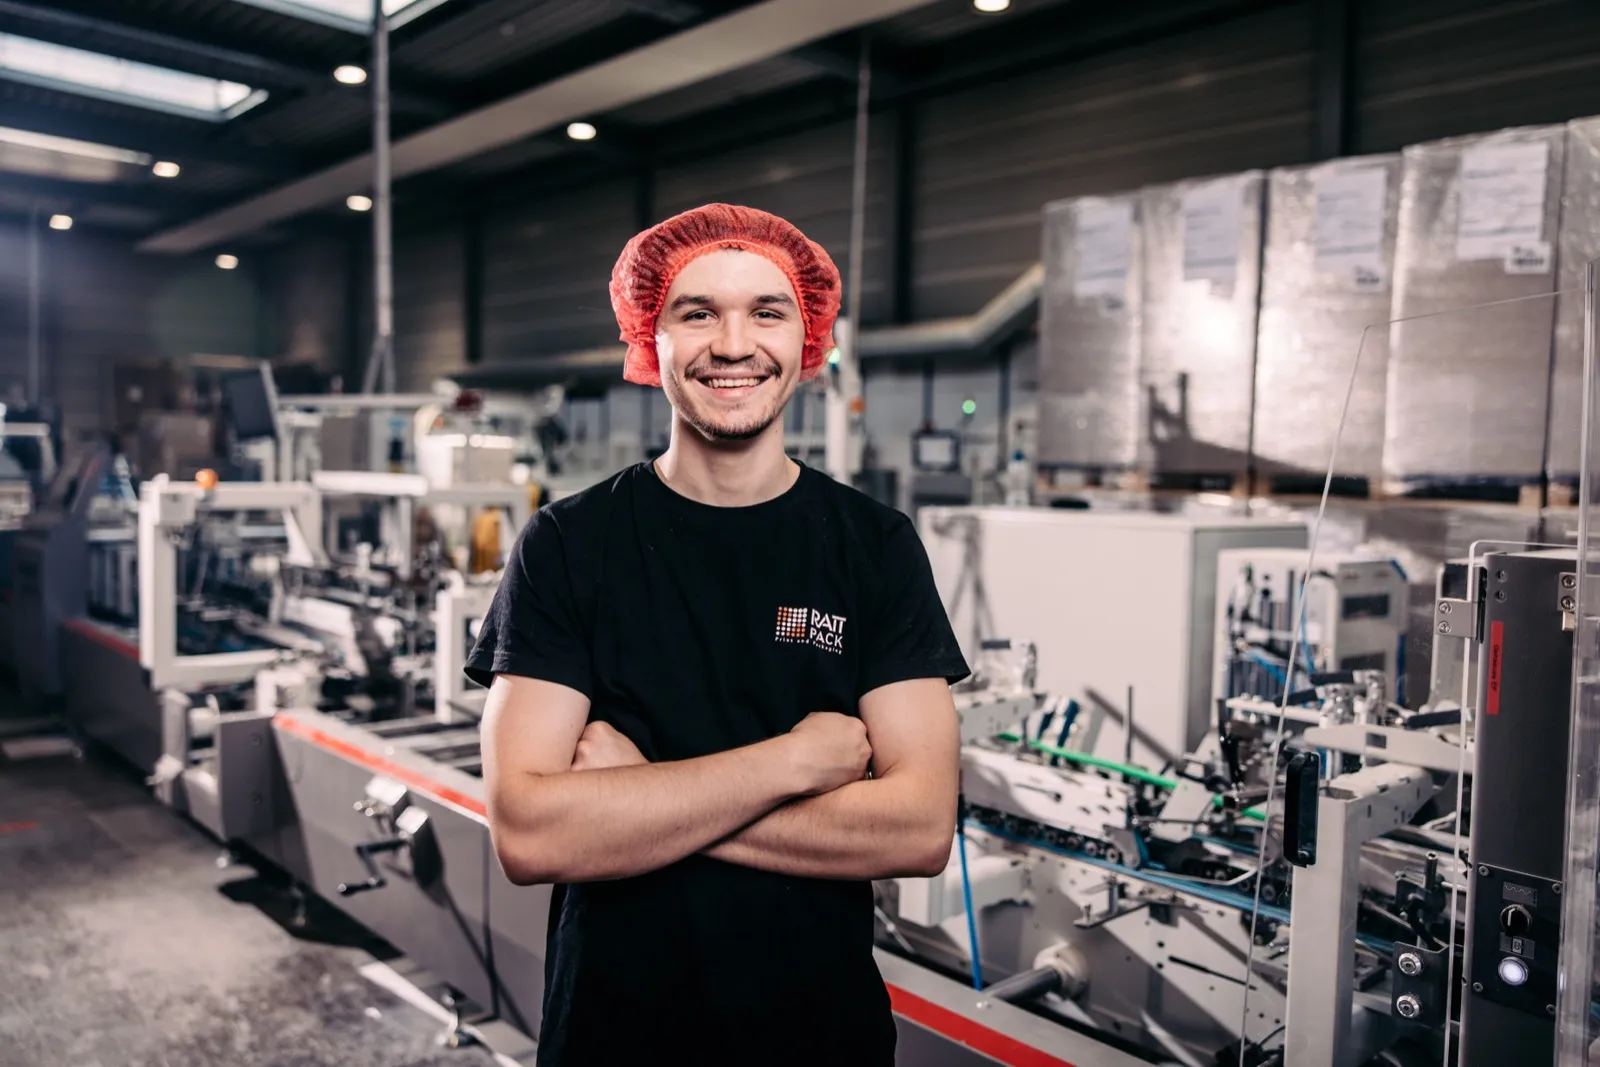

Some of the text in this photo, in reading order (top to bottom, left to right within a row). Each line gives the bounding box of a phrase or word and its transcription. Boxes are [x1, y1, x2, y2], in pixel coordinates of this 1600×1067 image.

[810, 608, 847, 634] RATT
[809, 626, 843, 649] PACK
[812, 640, 843, 655] Packaging
